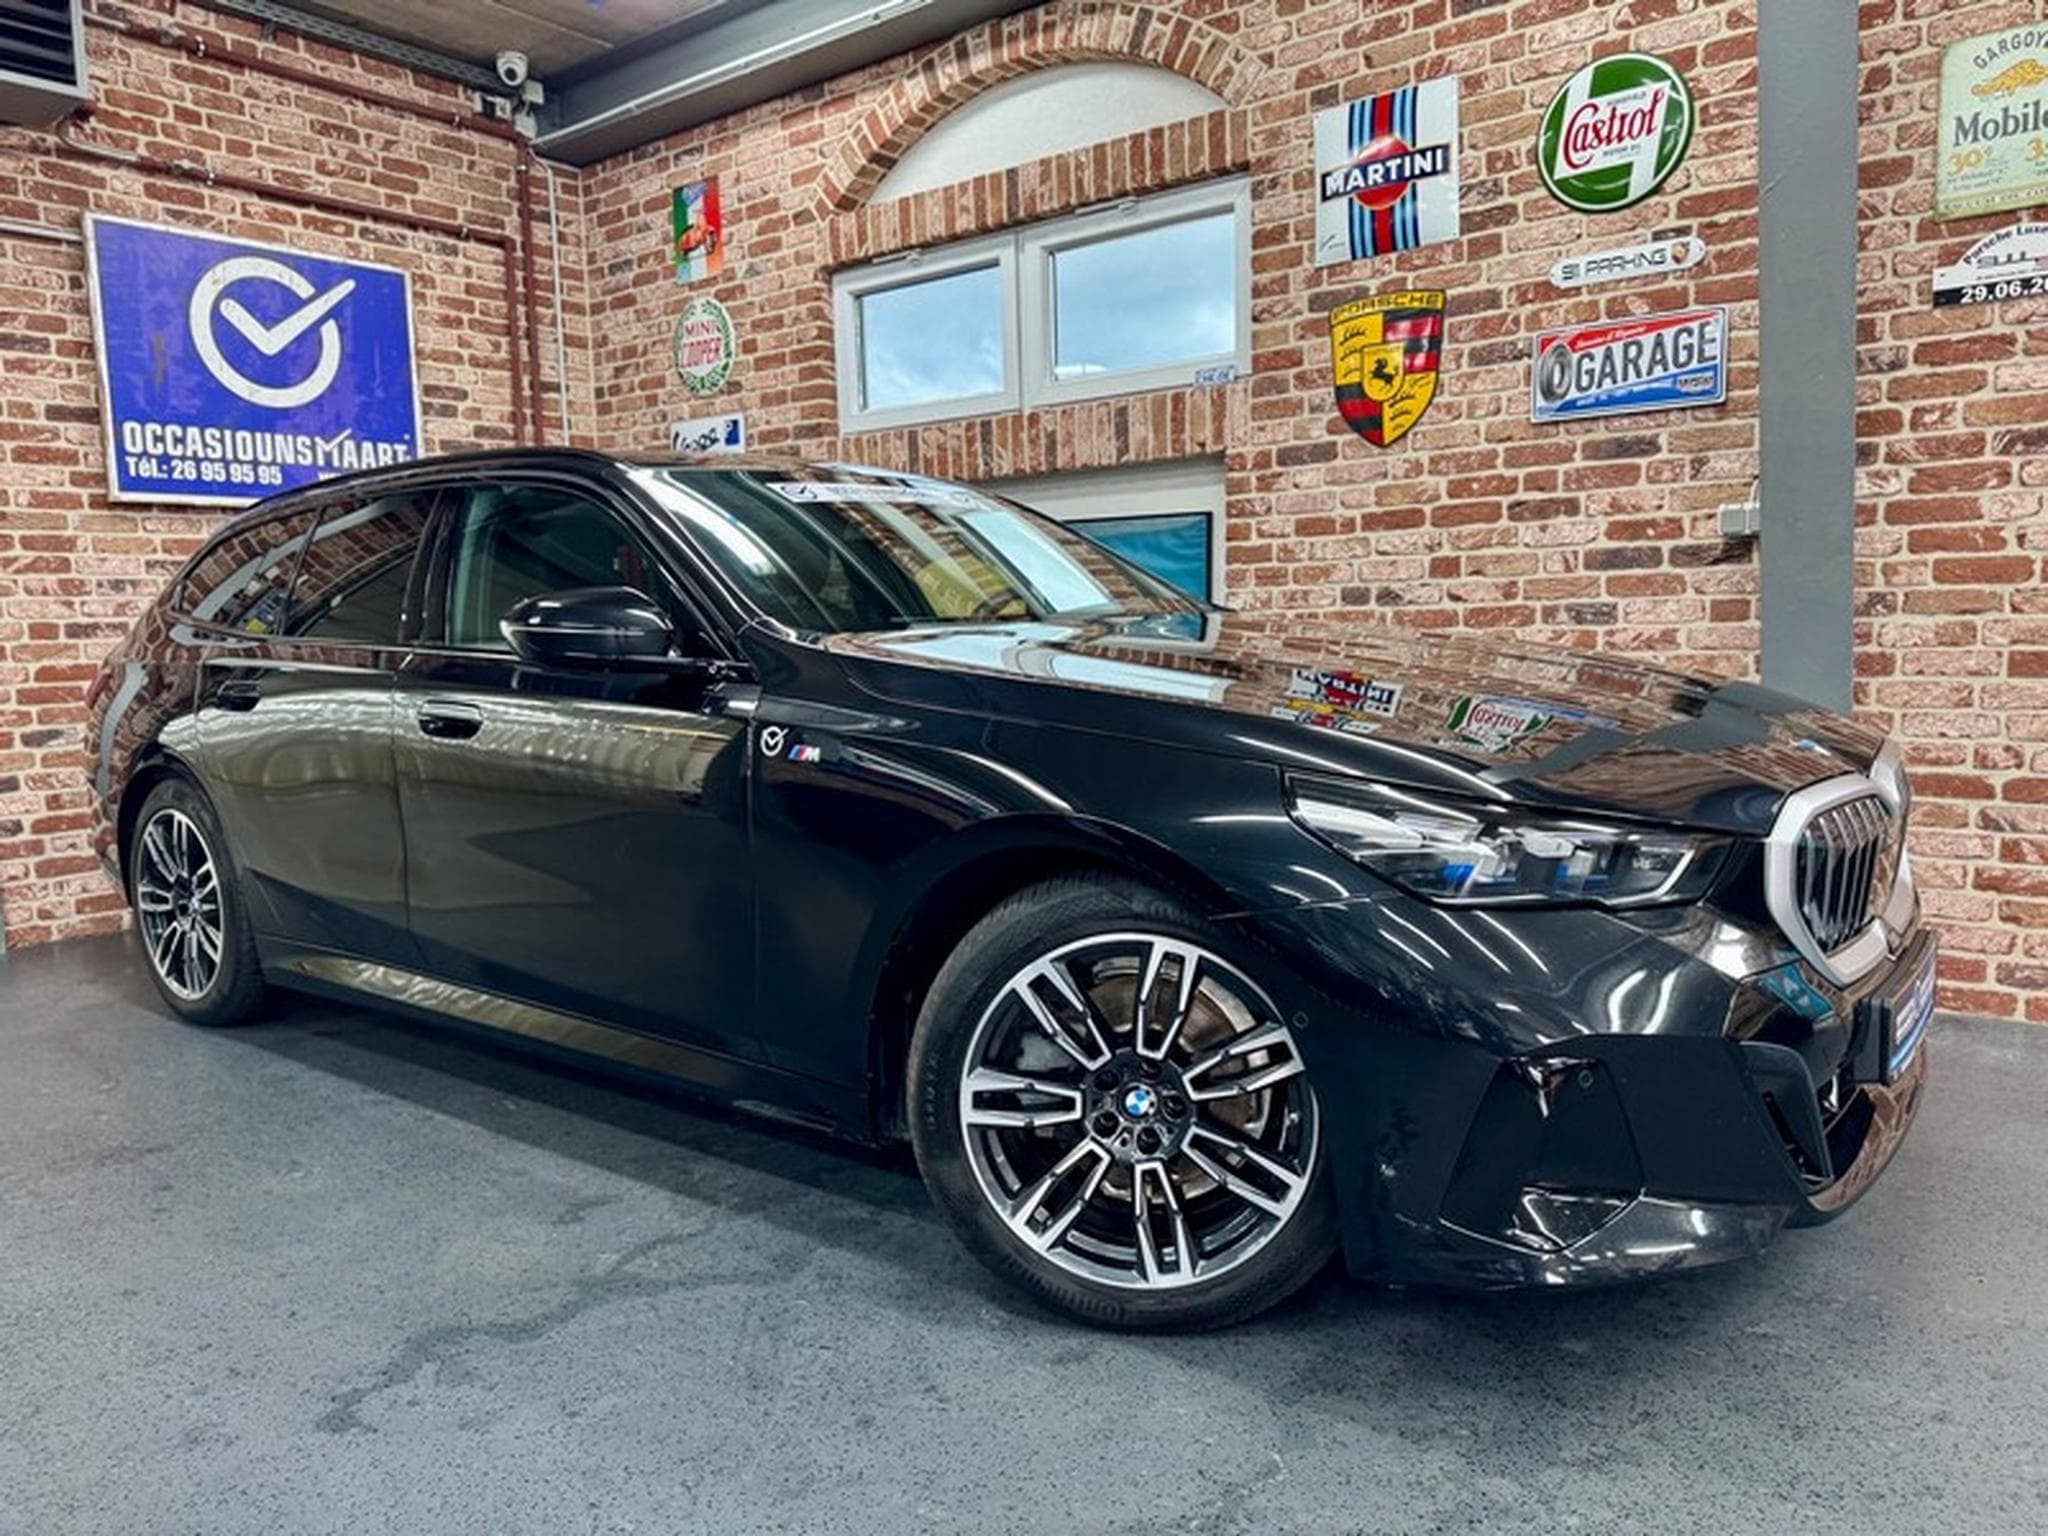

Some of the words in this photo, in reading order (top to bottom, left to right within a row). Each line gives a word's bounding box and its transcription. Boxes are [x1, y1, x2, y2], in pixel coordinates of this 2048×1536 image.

[1564, 89, 1665, 169] Castrol
[1325, 149, 1443, 197] MARTINI
[1586, 248, 1667, 275] PARKING
[1333, 294, 1440, 320] PORSCHE
[682, 336, 722, 368] COOPER
[1574, 320, 1718, 393] GARAGE
[122, 420, 409, 469] OCCASIOUNSMAART
[171, 459, 197, 480] 26
[201, 461, 227, 482] 95
[229, 462, 255, 483] 95
[257, 464, 282, 485] 95
